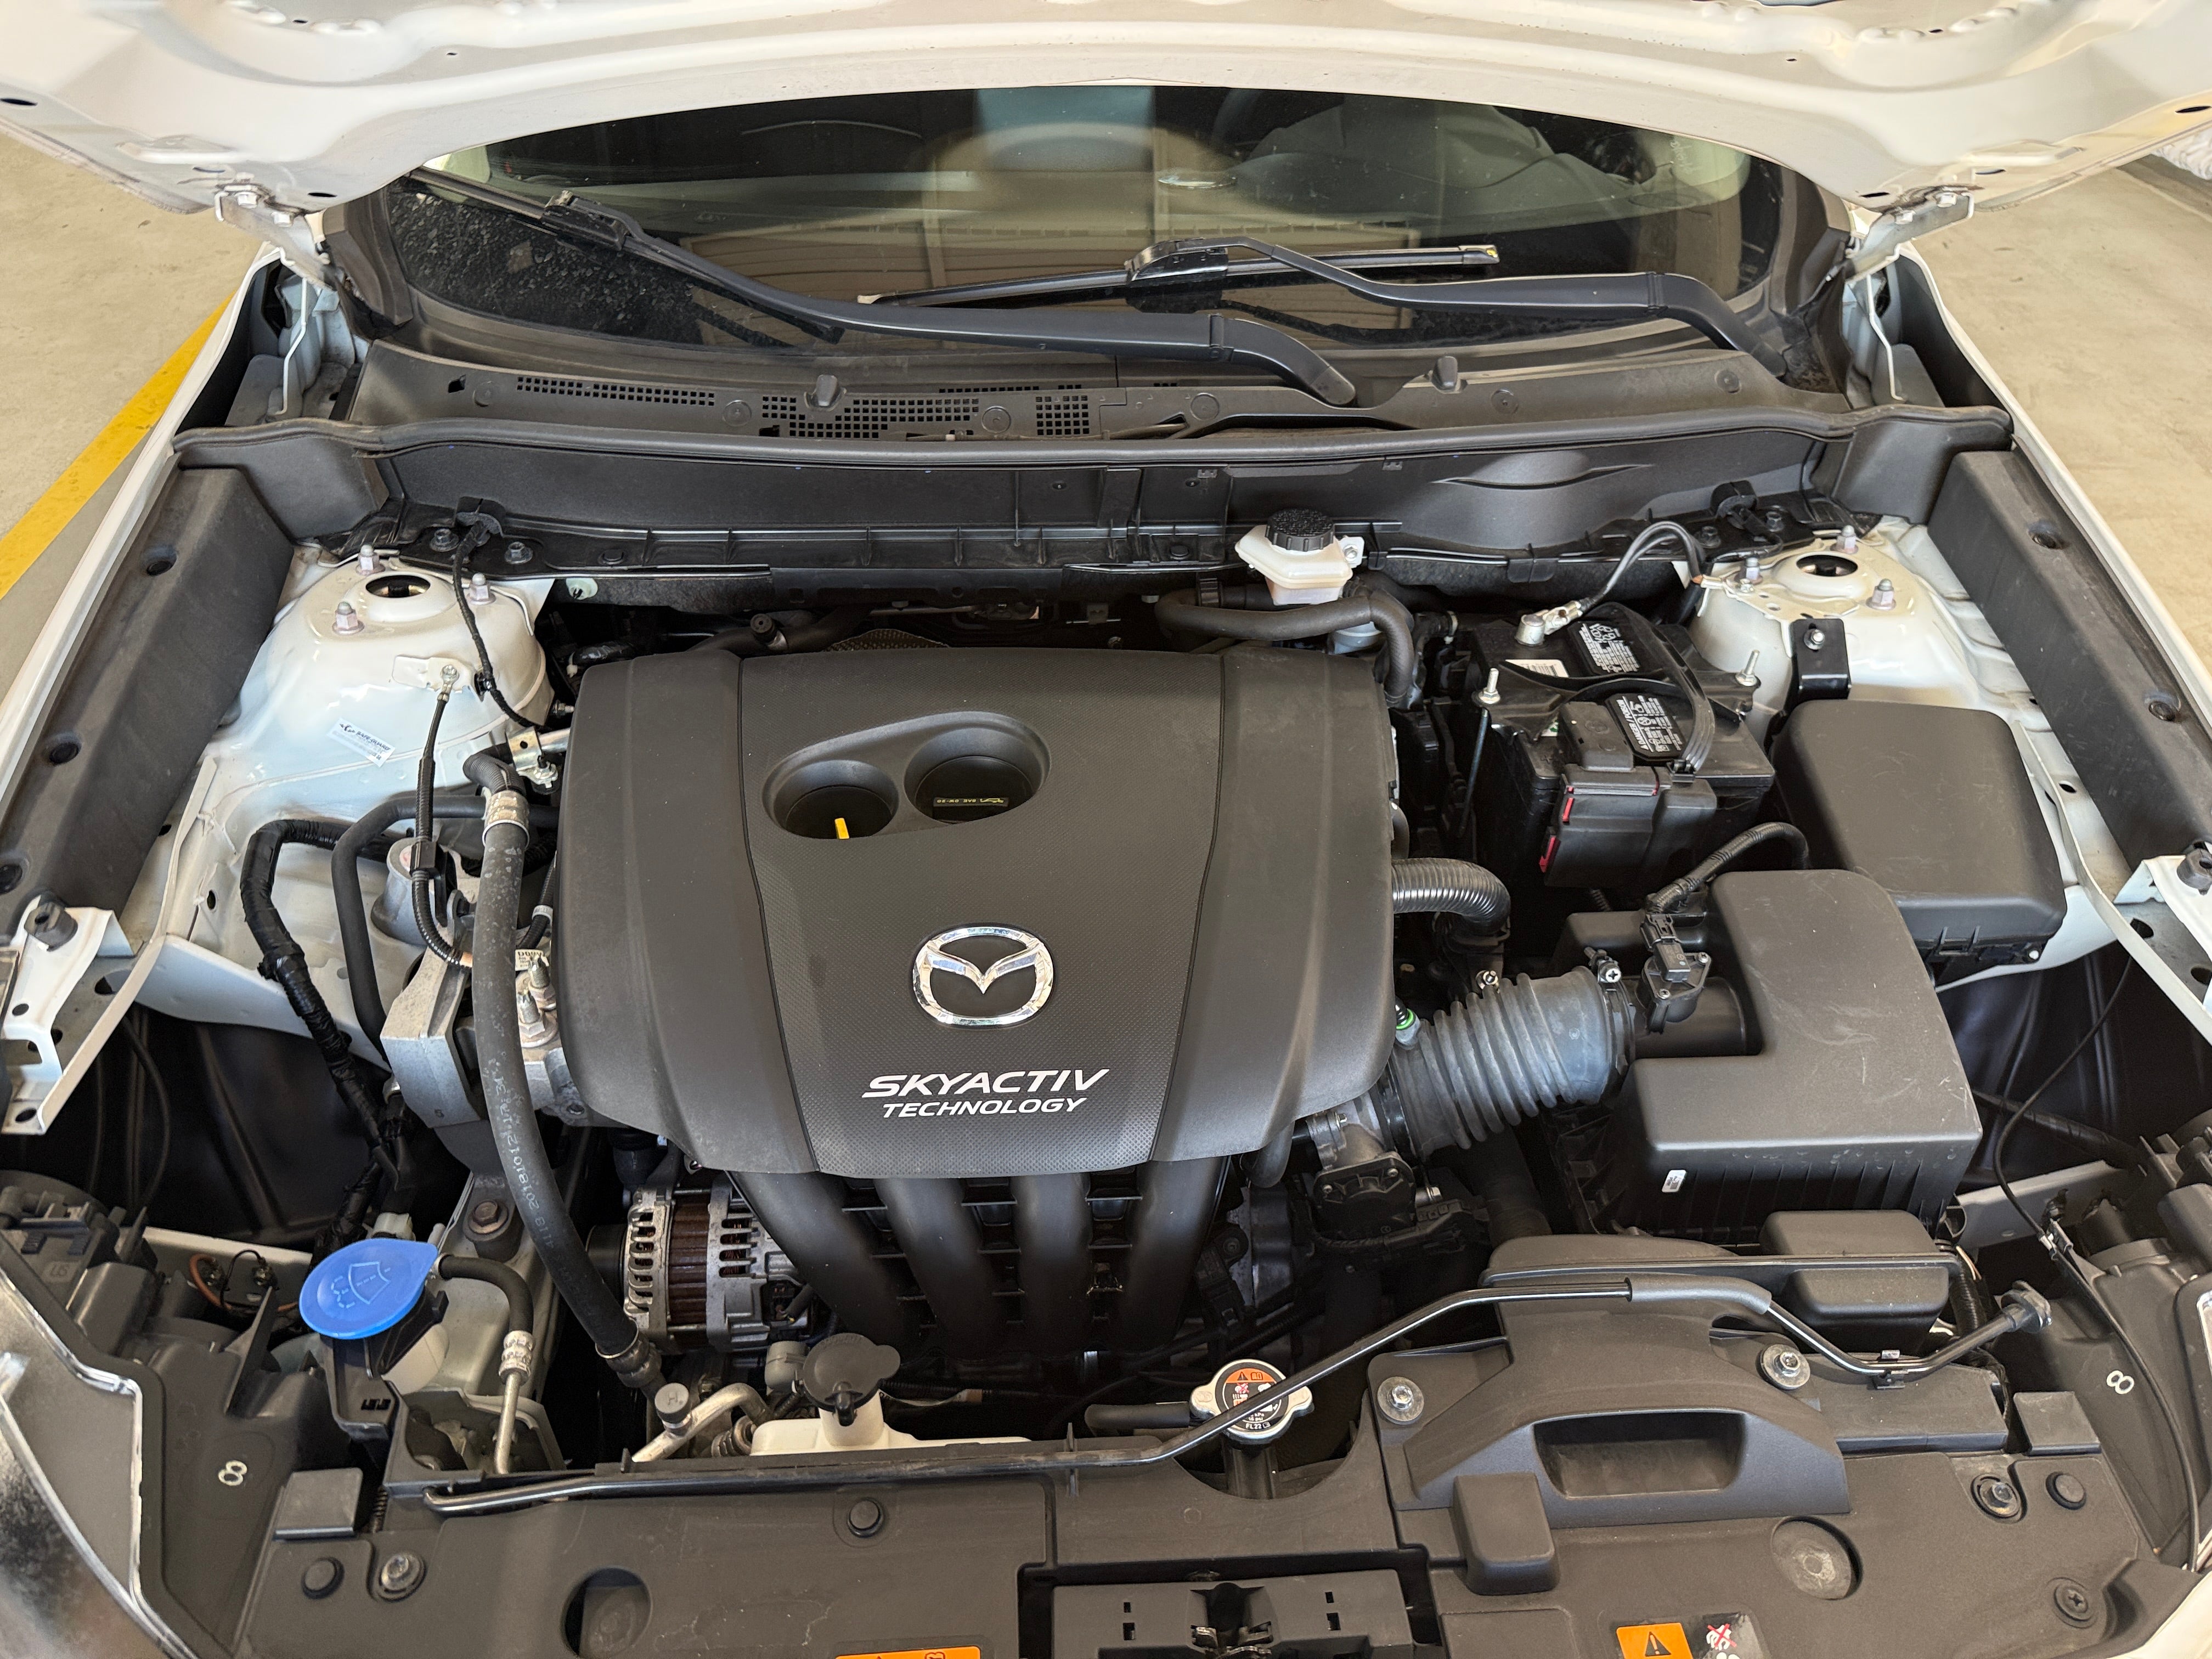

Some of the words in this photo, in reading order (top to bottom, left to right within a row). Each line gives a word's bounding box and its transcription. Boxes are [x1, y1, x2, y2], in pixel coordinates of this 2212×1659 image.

[861, 1069, 1110, 1098] SKYACTIV
[883, 1098, 1087, 1118] TECHNOLOGY
[2106, 1370, 2135, 1395] 8
[218, 1460, 247, 1486] 8
